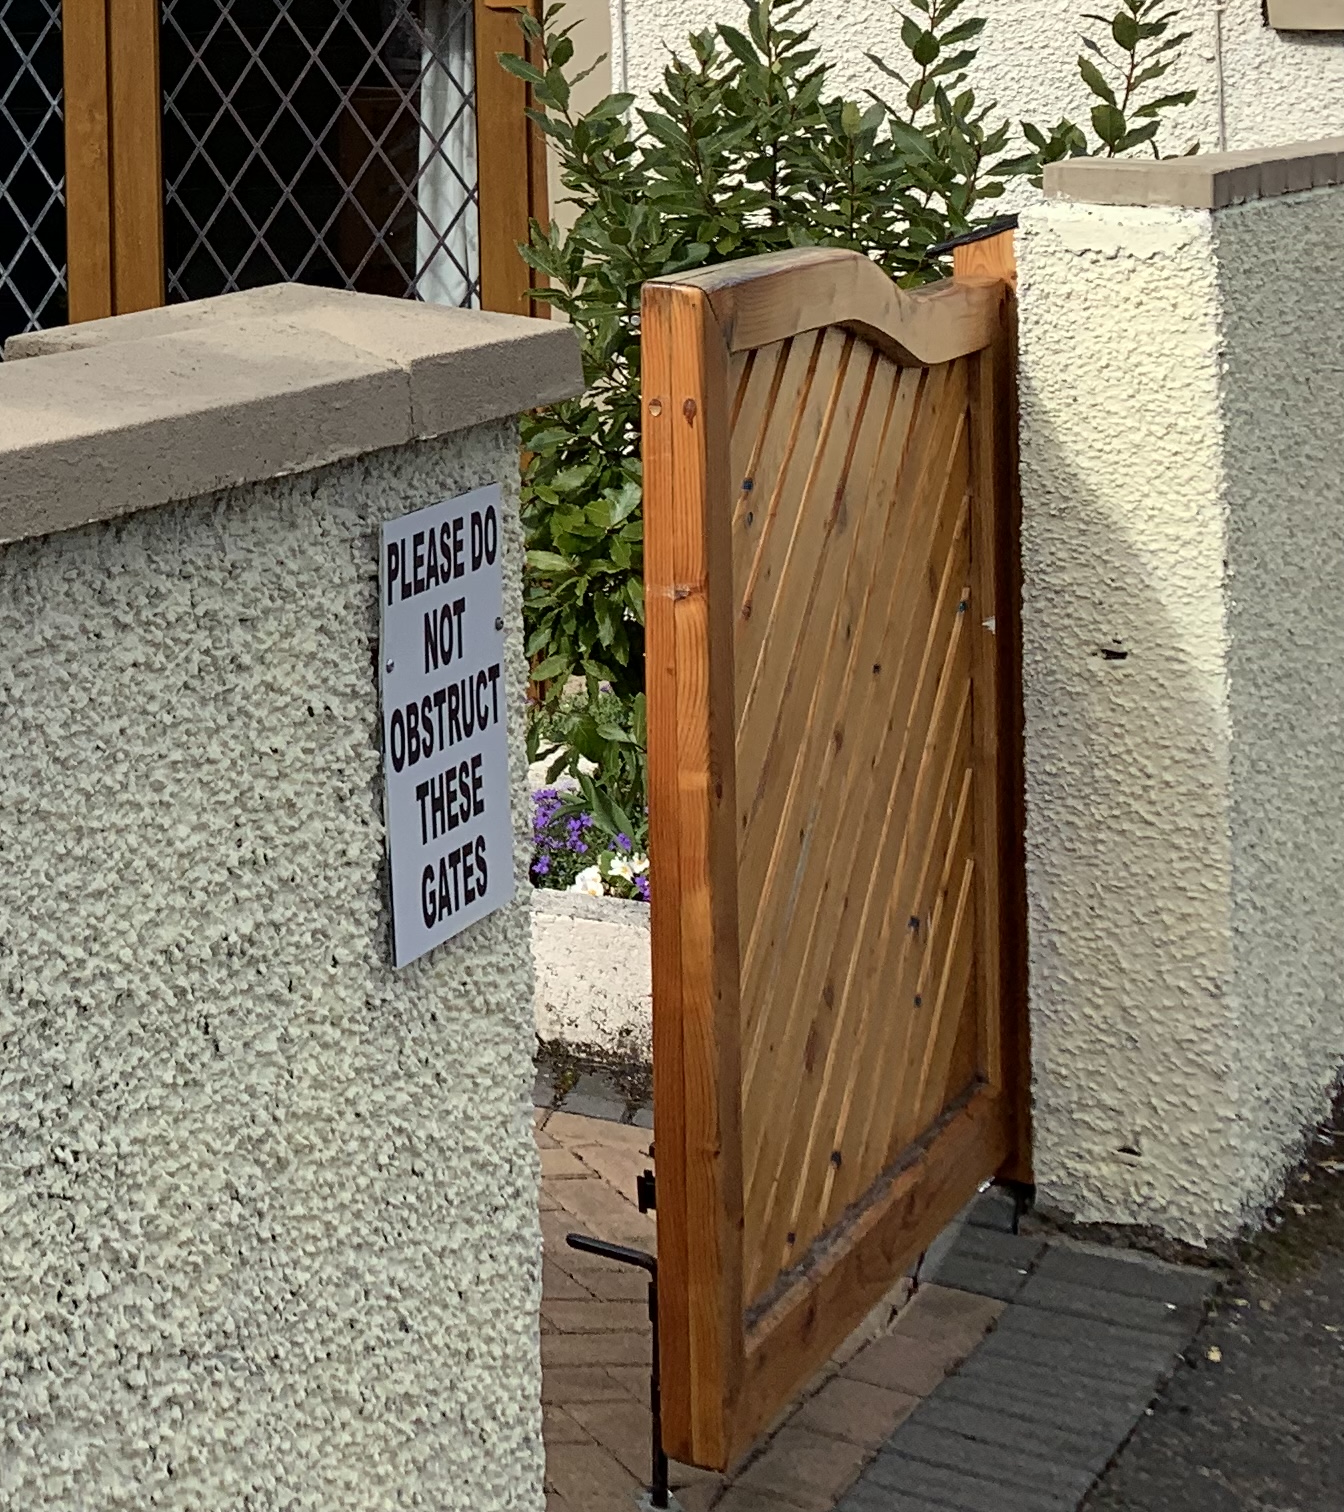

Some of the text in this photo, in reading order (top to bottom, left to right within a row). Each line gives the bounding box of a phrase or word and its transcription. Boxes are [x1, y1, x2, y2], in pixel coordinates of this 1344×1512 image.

[387, 504, 498, 606] PLEASE DO
[424, 597, 466, 675] NOT
[390, 663, 500, 774] OBSTRUCT
[415, 752, 485, 846] THESE
[421, 834, 488, 930] GATES
